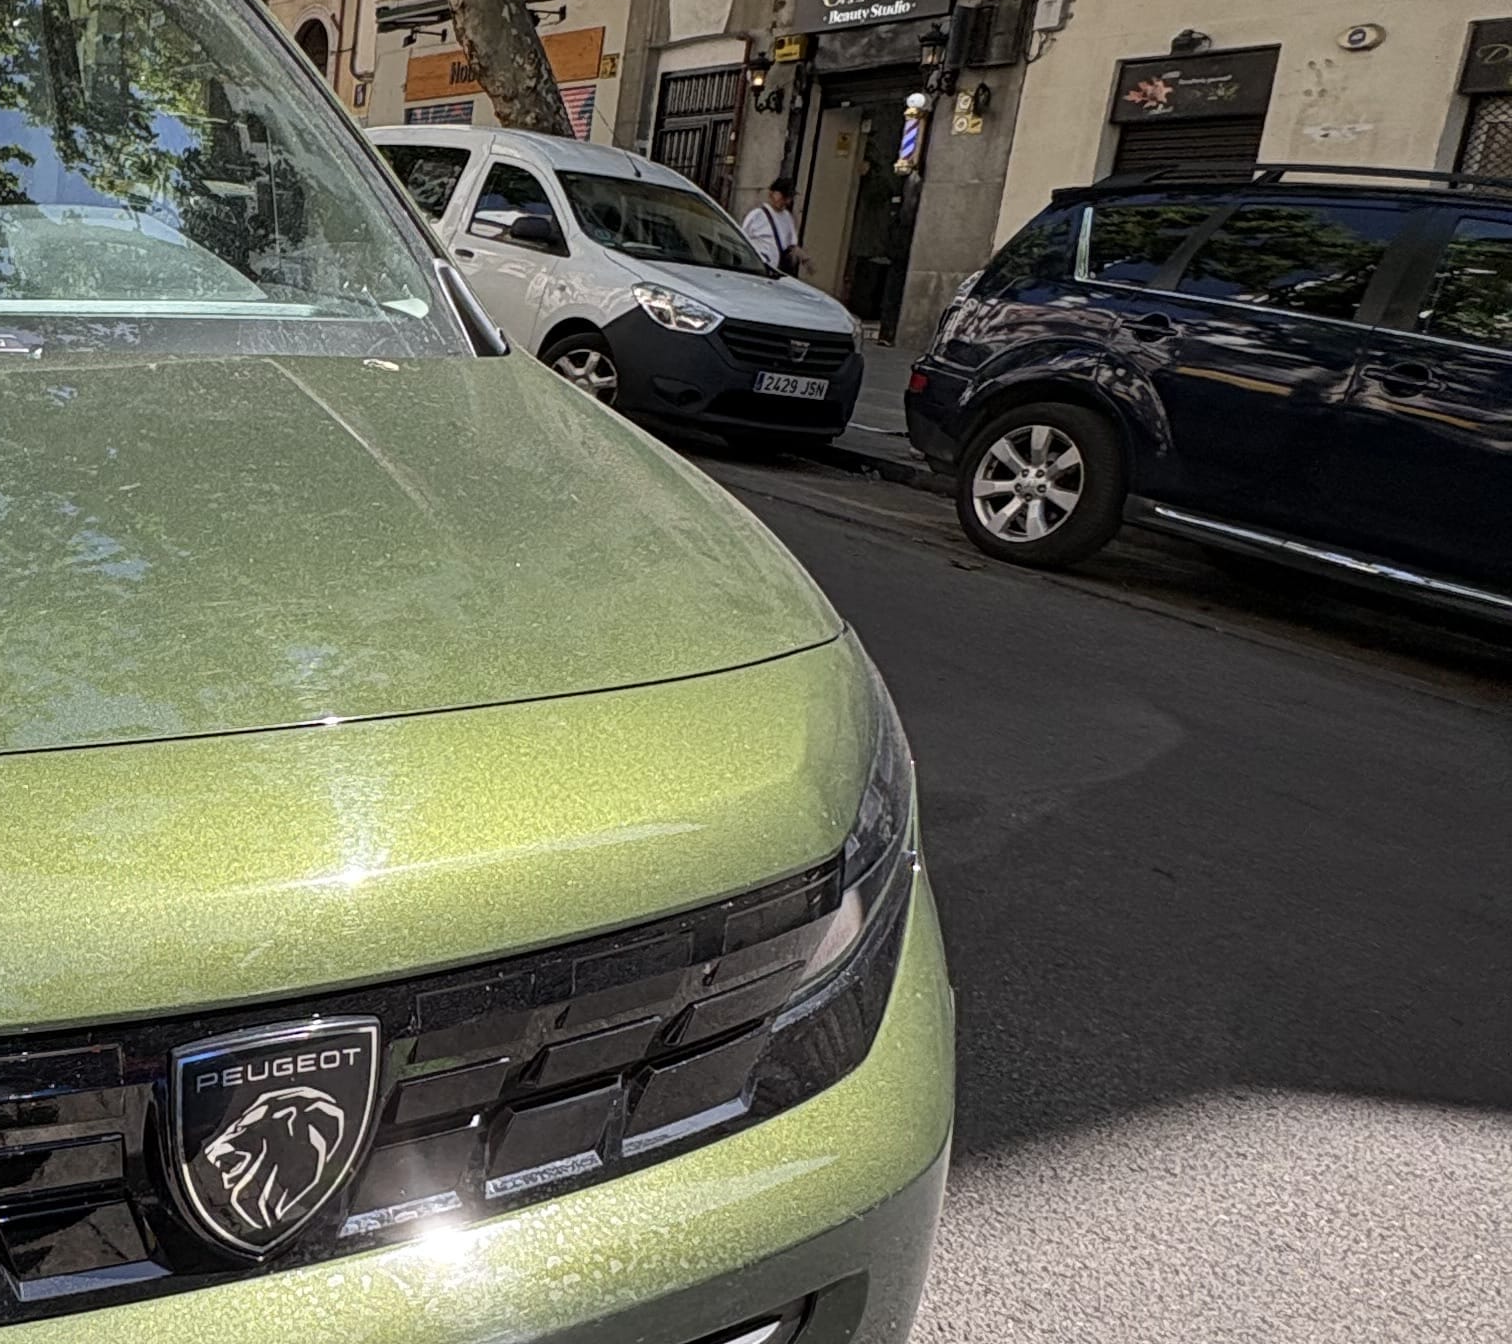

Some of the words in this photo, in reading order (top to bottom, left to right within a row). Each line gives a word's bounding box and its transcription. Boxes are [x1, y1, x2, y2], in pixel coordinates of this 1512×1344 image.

[828, 9, 870, 25] Beauty
[870, 0, 911, 18] Studio
[764, 375, 799, 394] 2429
[799, 380, 826, 398] JSN
[196, 1047, 362, 1094] PEUGEOT
